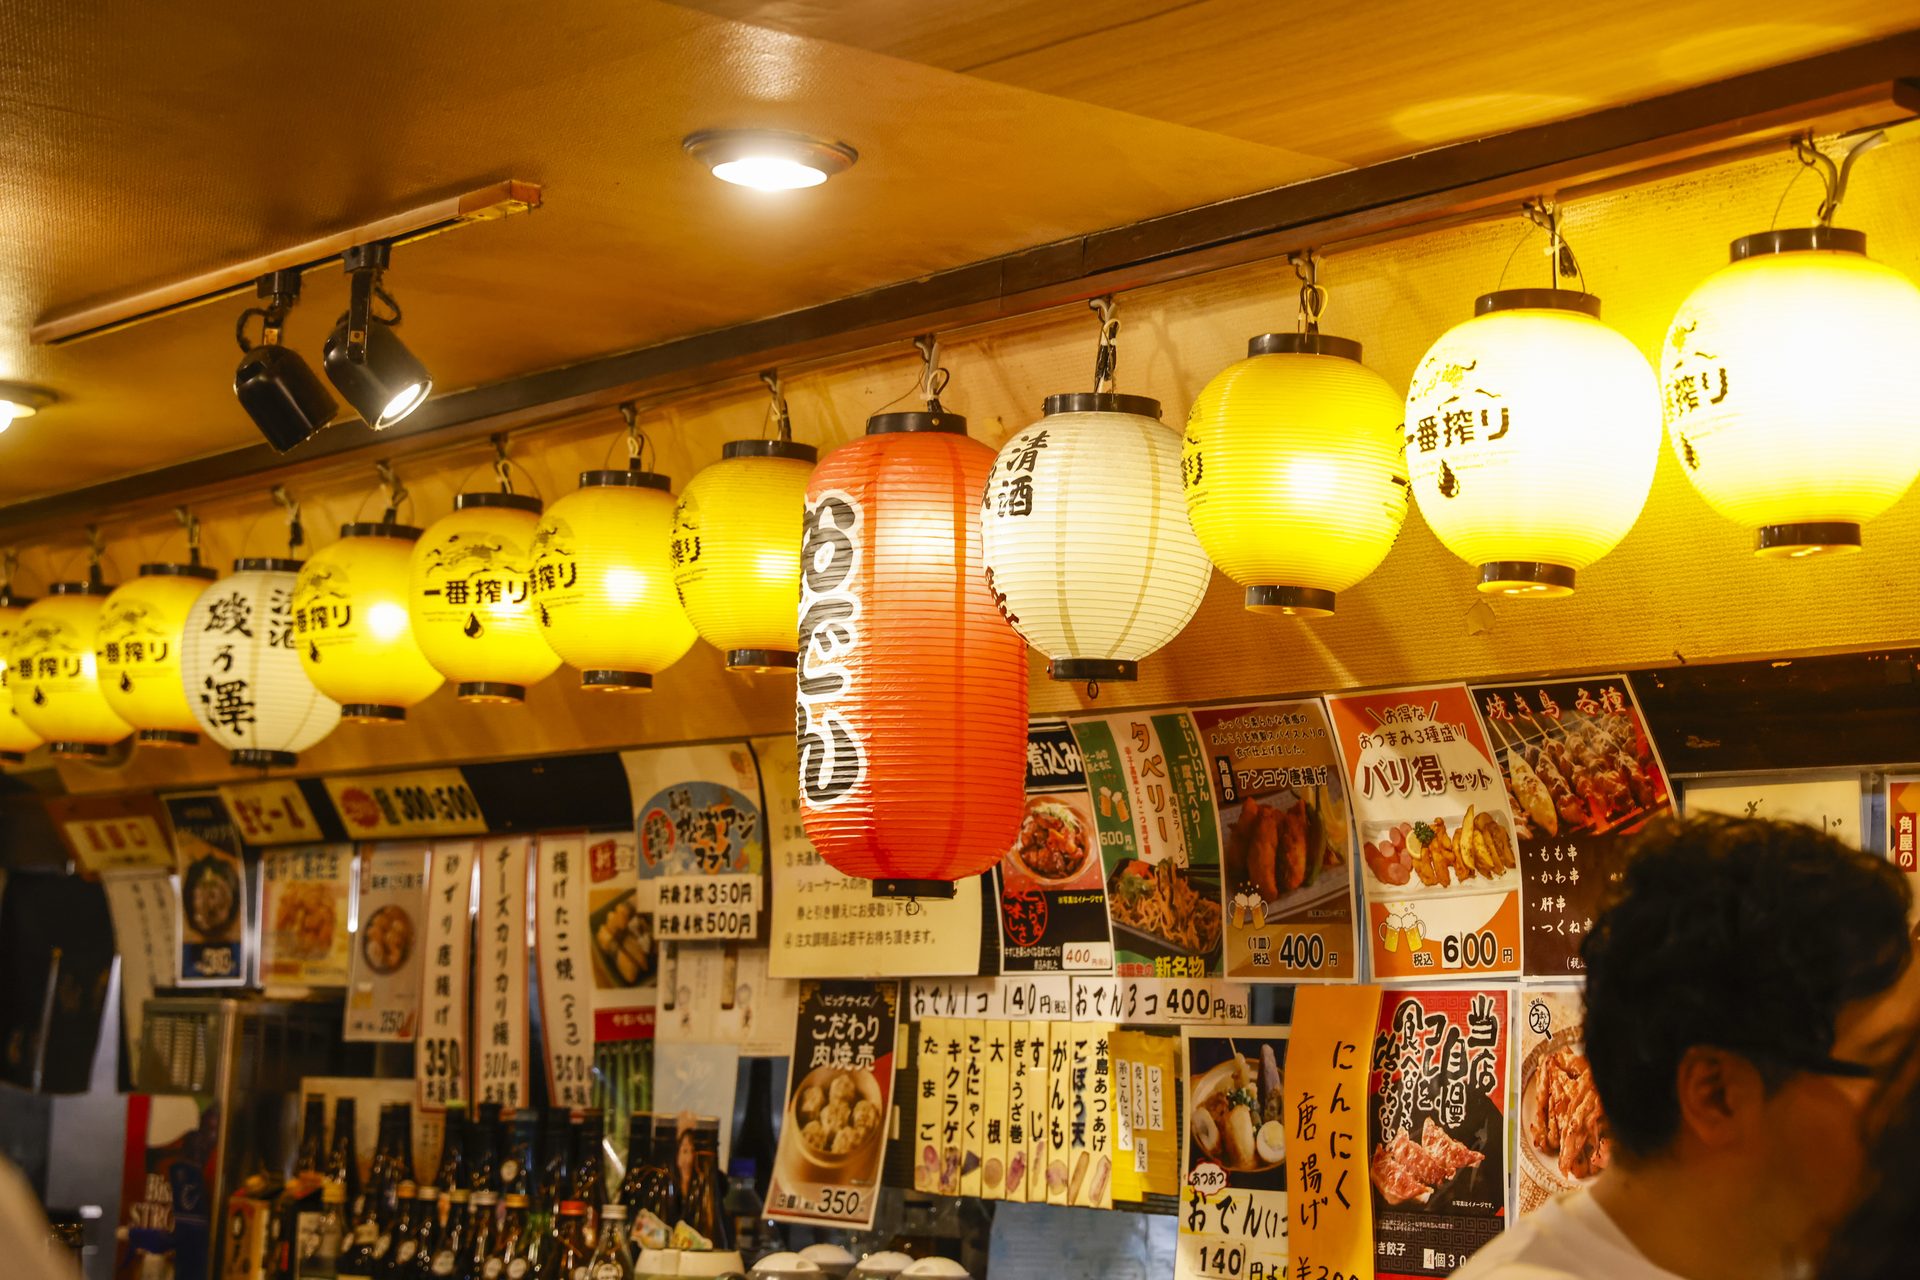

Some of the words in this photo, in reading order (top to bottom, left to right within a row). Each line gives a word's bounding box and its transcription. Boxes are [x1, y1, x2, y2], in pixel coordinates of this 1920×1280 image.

[1406, 407, 1509, 453] 一番搾り
[998, 430, 1051, 518] 清酒
[424, 579, 527, 605] 一番搾り
[1385, 704, 1426, 724] お得な
[1486, 689, 1560, 720] 焼き鳥
[1575, 686, 1626, 714] 各種
[1359, 723, 1467, 750] おつまみ3種盛り
[1027, 741, 1084, 778] 煮込み
[1237, 766, 1328, 790] アンコウ唐揚げ
[1362, 755, 1445, 797] バリ得
[1449, 767, 1492, 791] セット
[1130, 722, 1168, 843] タベリー
[1155, 956, 1206, 978] 新名物
[1413, 953, 1434, 967] 税込
[914, 984, 988, 1016] おでん1コ
[1076, 983, 1158, 1018] おでん3コ
[812, 1013, 880, 1043] こだわり
[1467, 993, 1500, 1092] 当店
[810, 1042, 876, 1072] 肉焼売
[1436, 1026, 1469, 1128] 自慢
[943, 1039, 962, 1143] キクラゲ
[965, 1036, 981, 1139] こんにゃく
[988, 1038, 1005, 1144] 大根
[1010, 1039, 1026, 1144] ぎょうざ巻
[1030, 1037, 1045, 1142] すじ
[1051, 1040, 1067, 1149] がんも
[1092, 1039, 1109, 1152] 糸島あつあげ
[1329, 1041, 1357, 1210] にんにく
[1192, 1173, 1225, 1186] あつあつ
[1296, 1092, 1328, 1230] 唐揚げ
